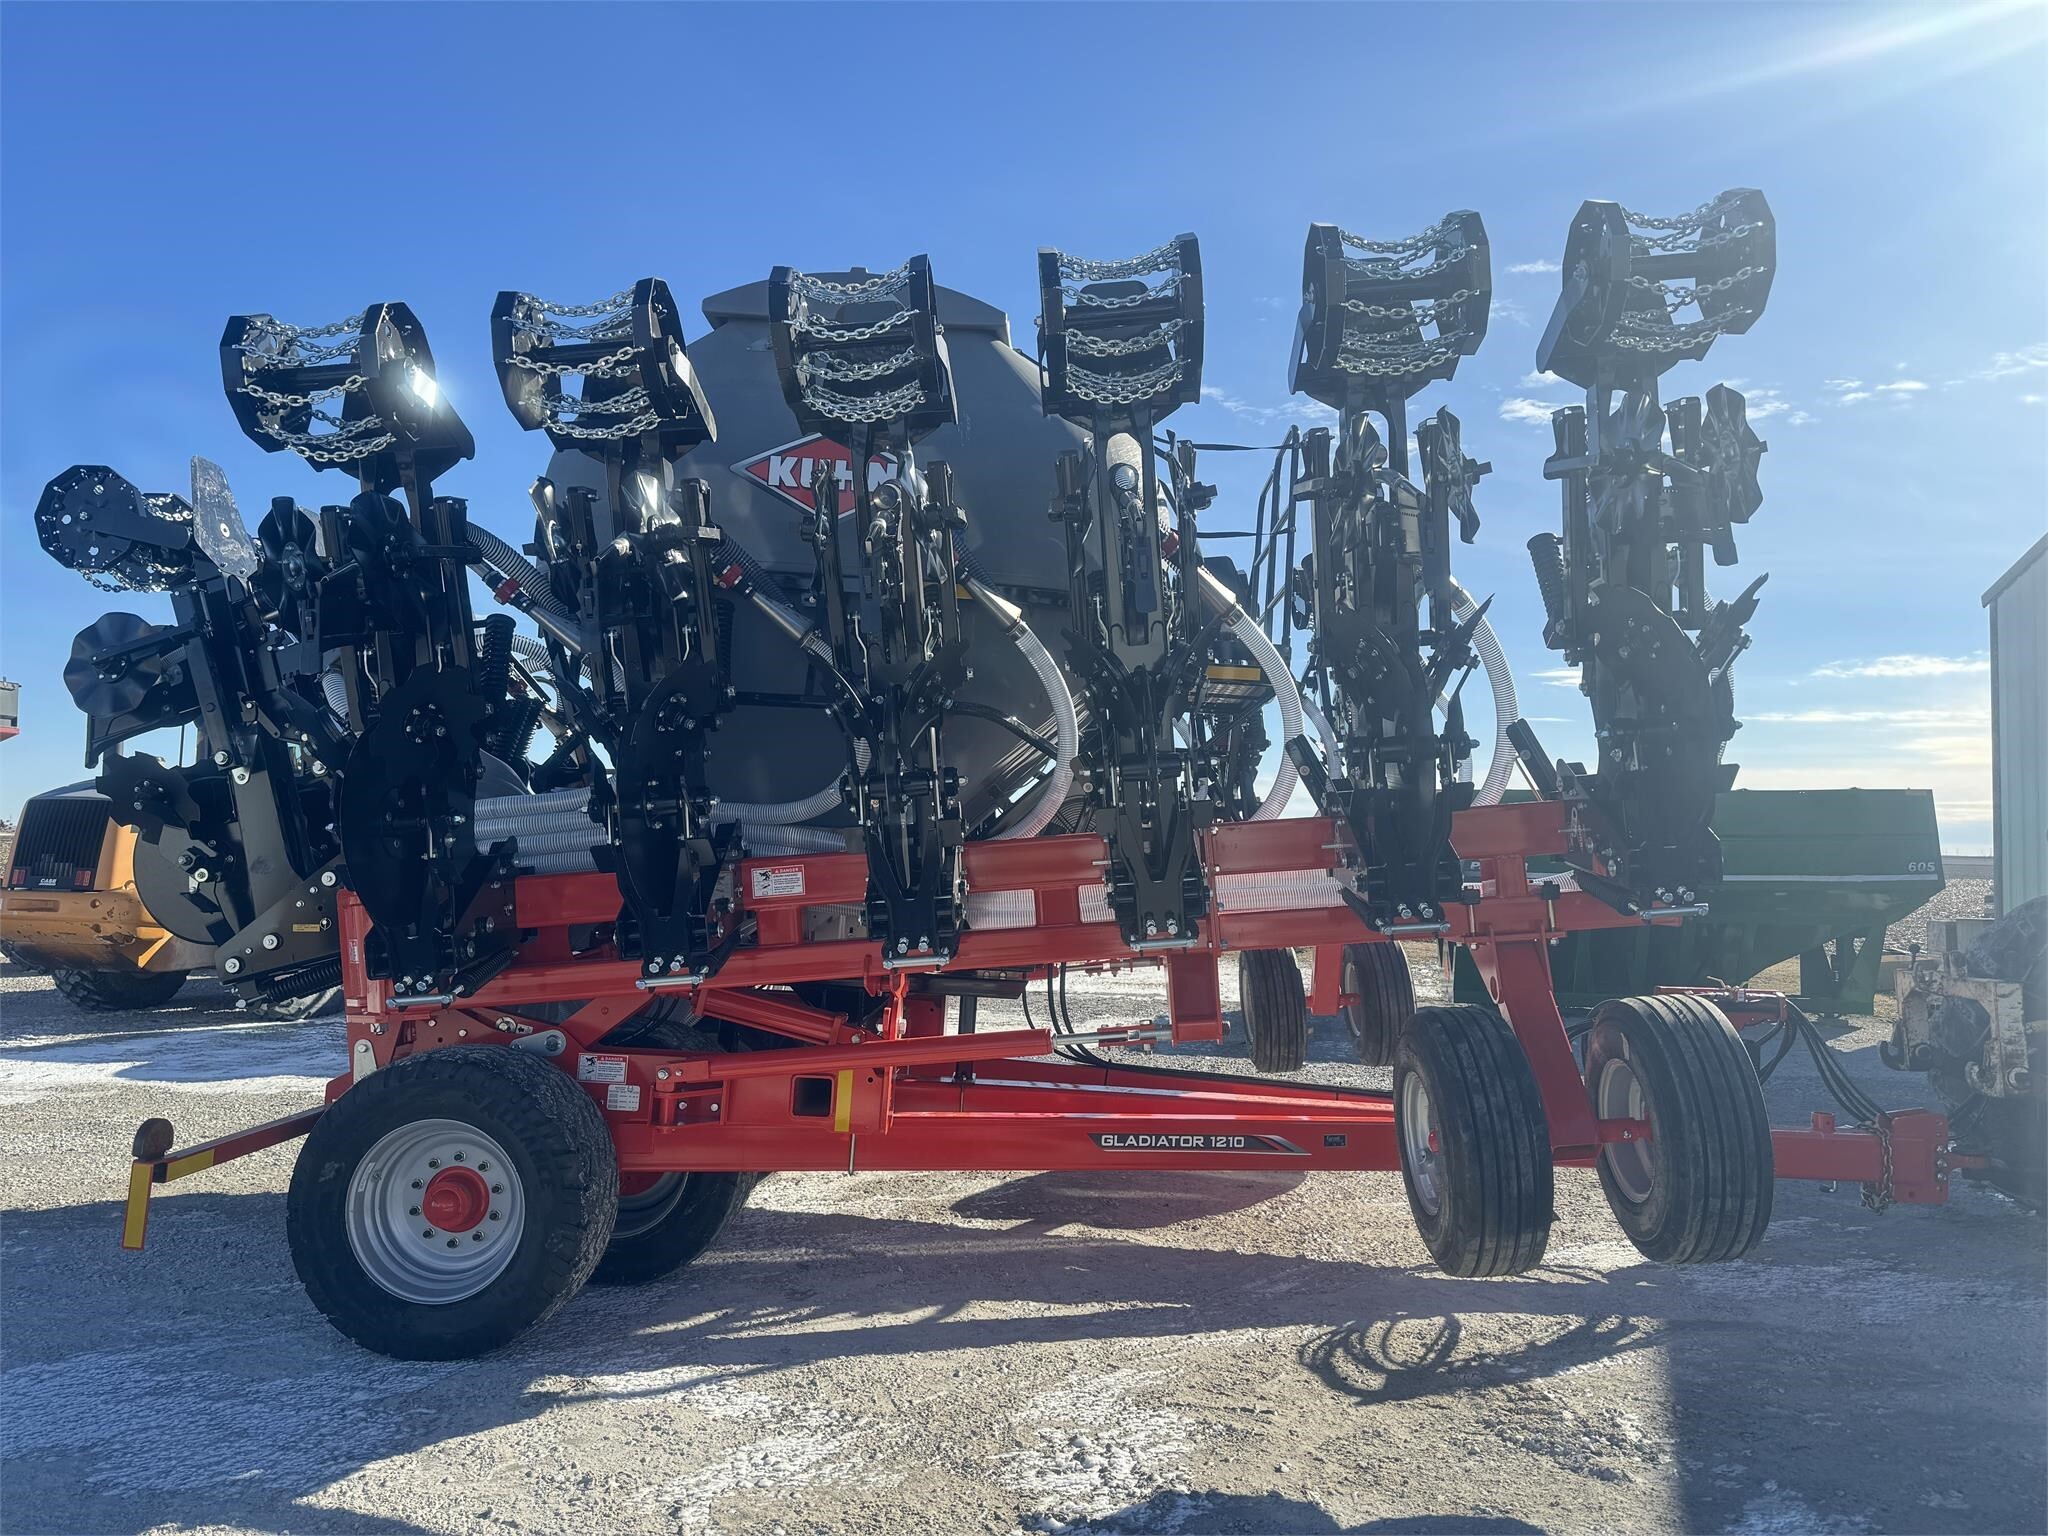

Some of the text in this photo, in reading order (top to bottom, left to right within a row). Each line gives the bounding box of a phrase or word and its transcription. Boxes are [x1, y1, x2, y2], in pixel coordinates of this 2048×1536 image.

[1908, 862, 1936, 872] 605
[1101, 1134, 1245, 1147] GLADIATOR 1210
